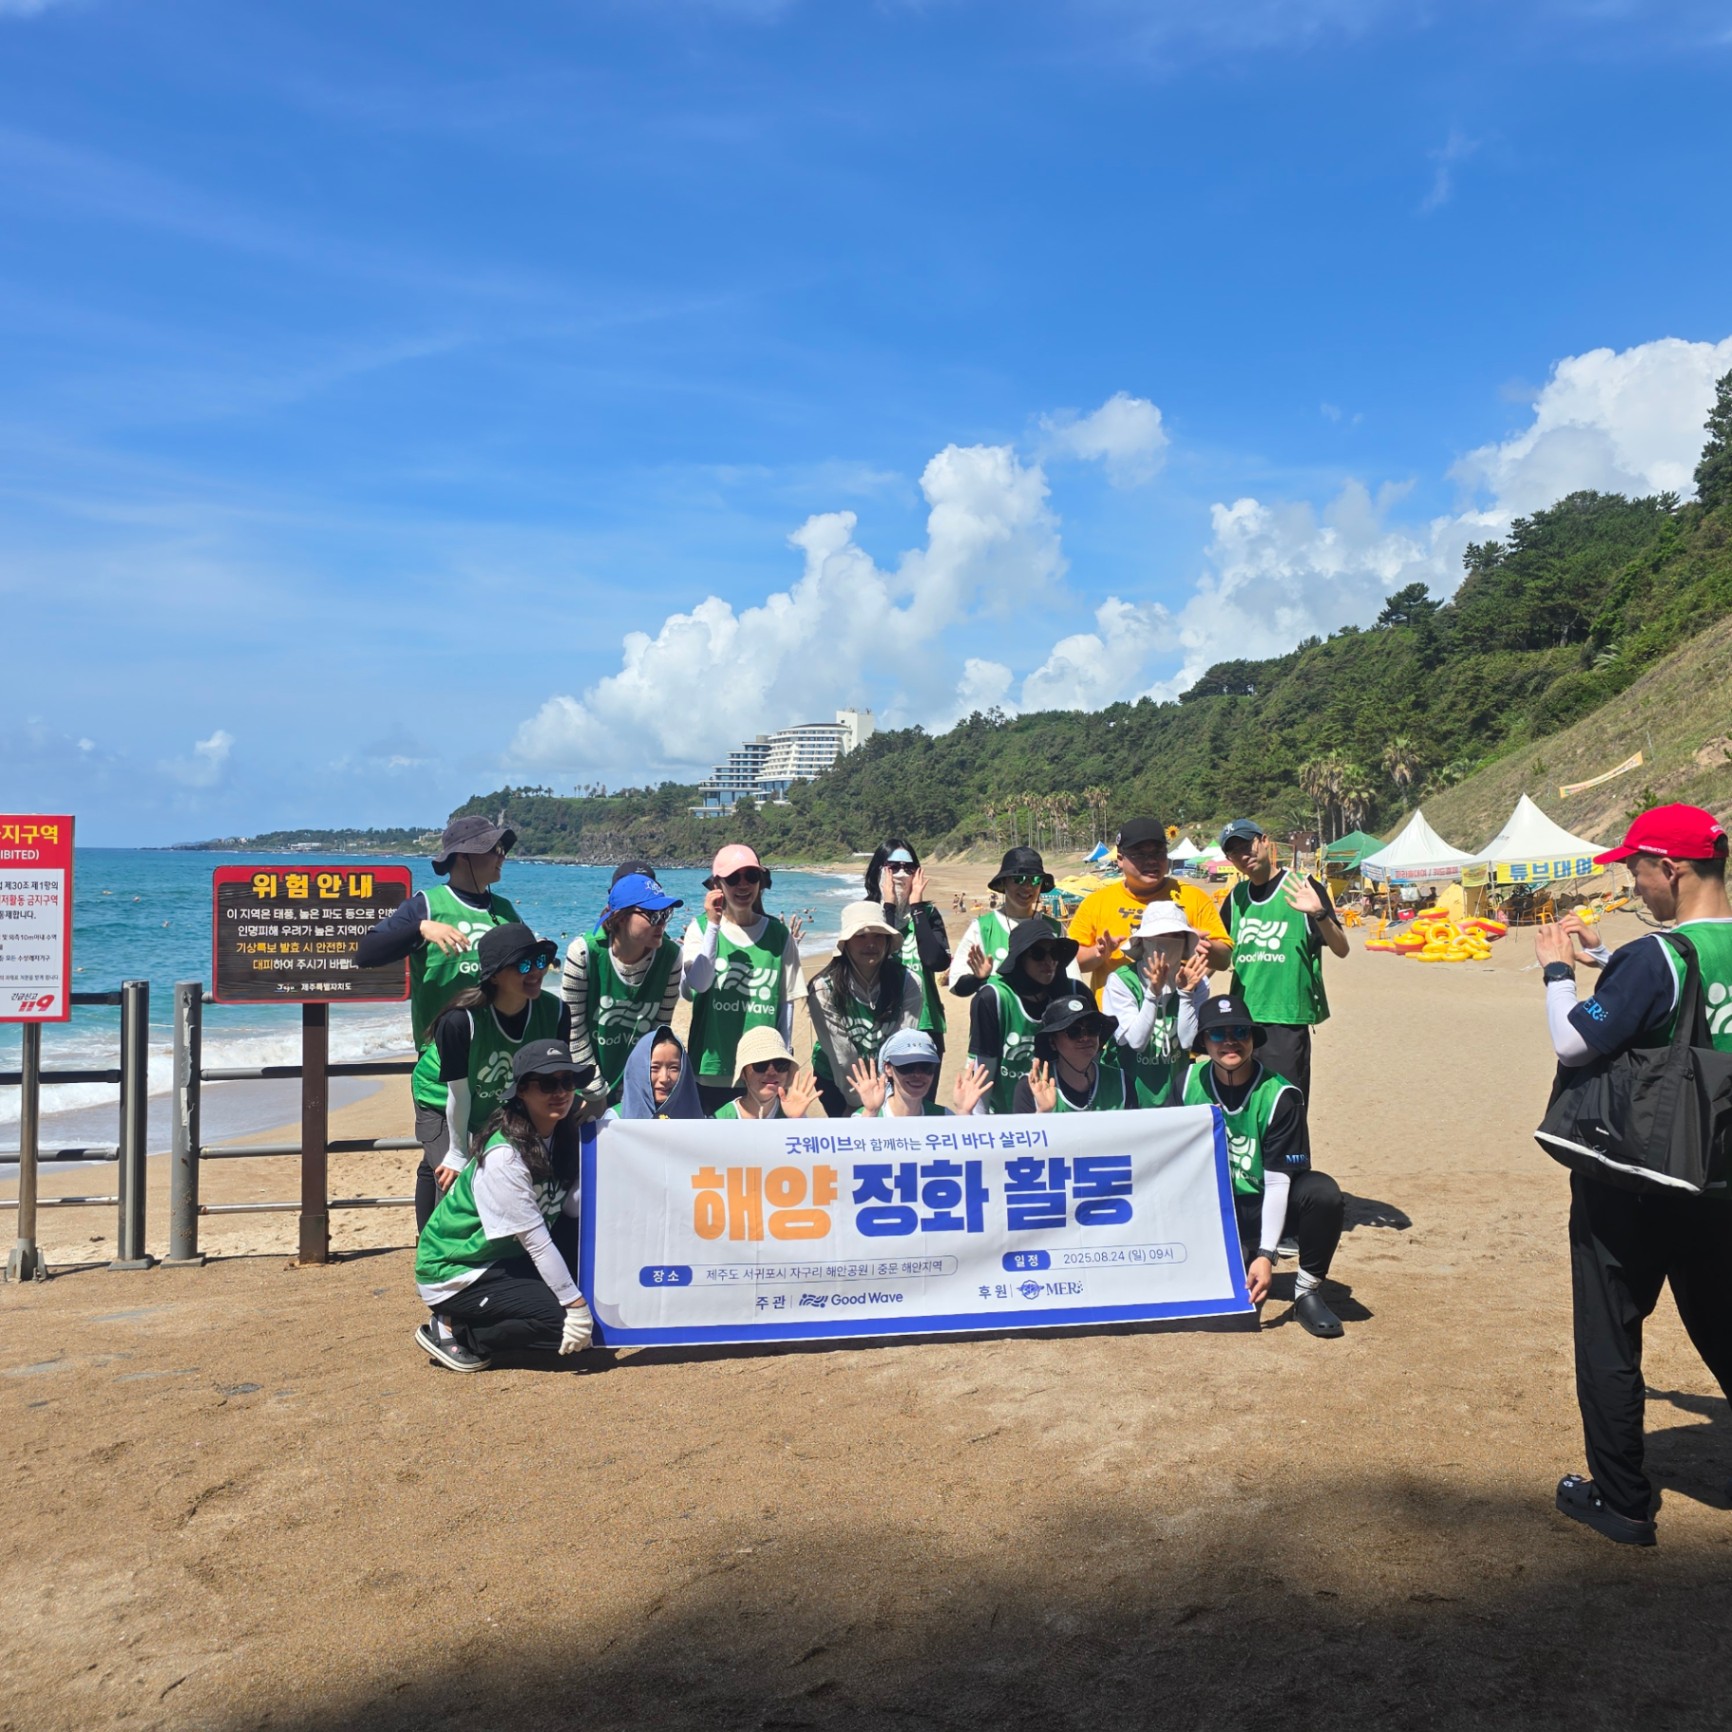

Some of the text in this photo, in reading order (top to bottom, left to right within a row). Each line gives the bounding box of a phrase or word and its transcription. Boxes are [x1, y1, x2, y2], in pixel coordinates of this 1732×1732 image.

[0, 825, 58, 845] 지구역
[0, 894, 58, 906] 저활동 금지구역
[227, 909, 237, 919] 이
[240, 909, 271, 920] 지역은
[273, 909, 297, 920] 태풍,
[299, 909, 320, 920] 높은
[322, 909, 343, 919] 파도
[345, 909, 375, 919] 등으로
[238, 926, 279, 936] 인명피해
[281, 926, 313, 936] 우려가
[314, 926, 335, 936] 높은
[236, 943, 358, 953] 기상특보 발효 시 안전한 지
[253, 959, 293, 970] 대피하여
[297, 959, 326, 970] 주시기
[301, 983, 352, 991] 제주특별자치도
[785, 1130, 1048, 1154] 굿웨이브와 함께하는 우리 바다 살리기
[691, 1155, 1134, 1241] 해양 정화 활동
[1063, 1251, 1125, 1264] 2025.08.24
[1128, 1249, 1147, 1263] (일)
[1149, 1247, 1174, 1260] 09시
[706, 1267, 740, 1281] 제주도
[743, 1267, 787, 1280] 서귀포시
[790, 1266, 822, 1279] 자구리
[826, 1264, 868, 1277] 해안공원
[878, 1262, 897, 1276] 중문
[901, 1260, 942, 1273] 해안지역
[831, 1292, 903, 1306] Good Wave
